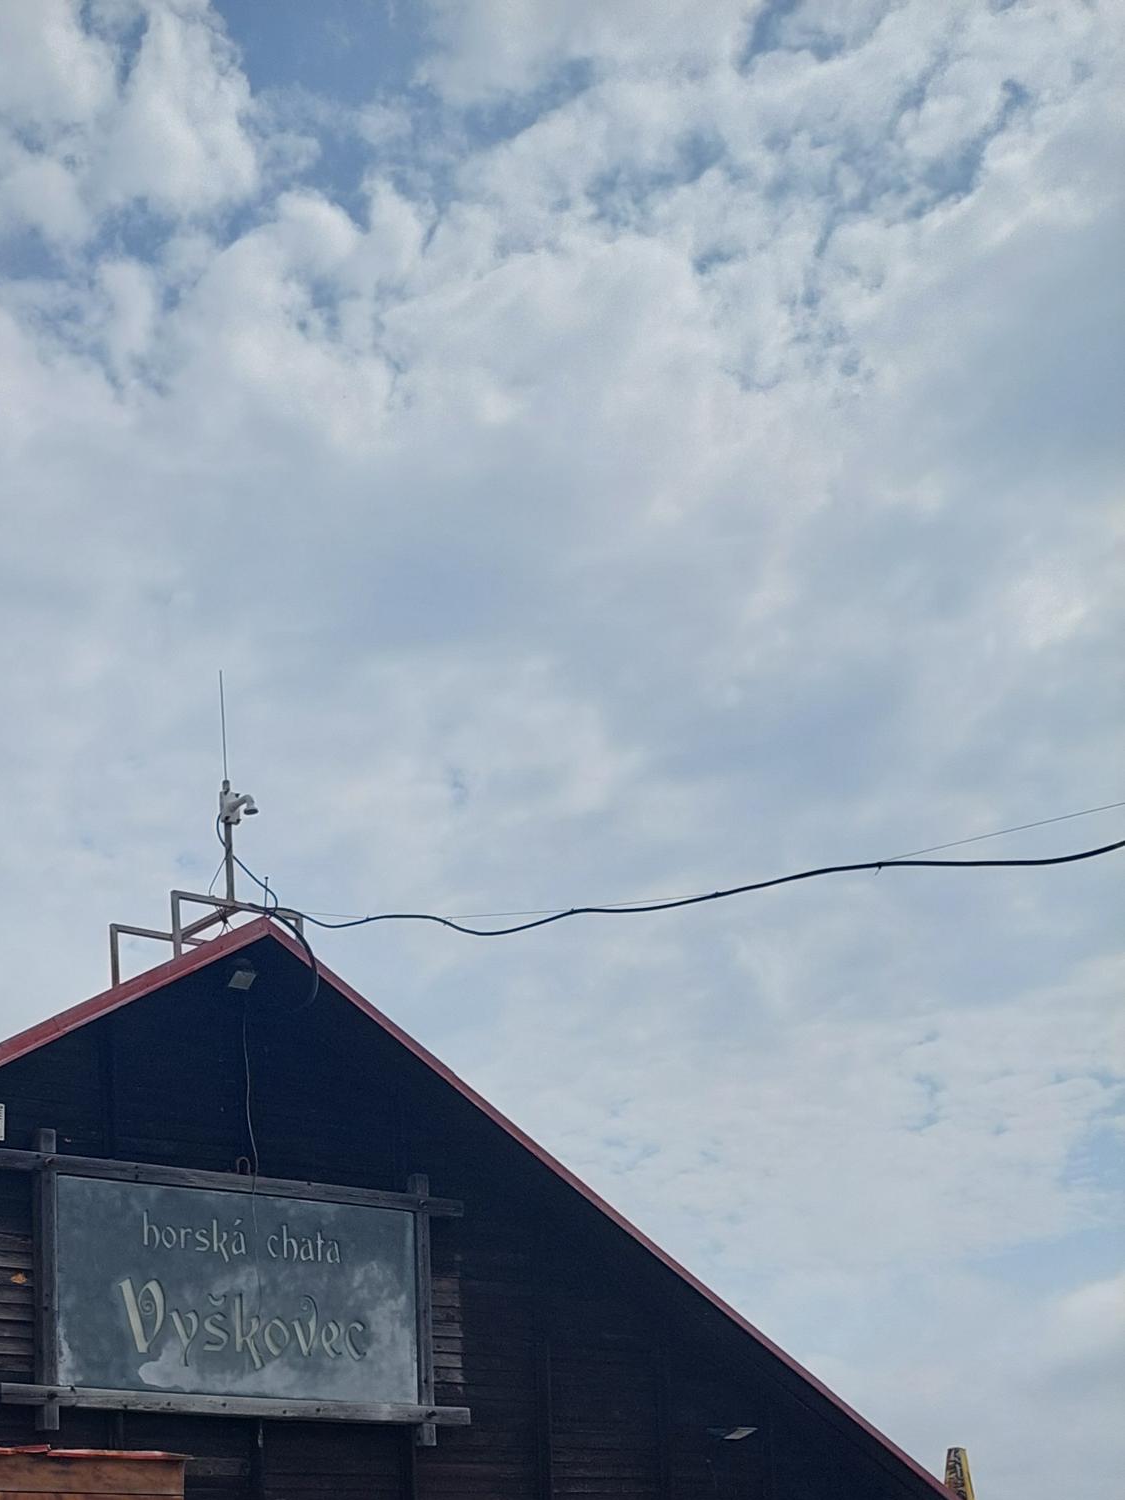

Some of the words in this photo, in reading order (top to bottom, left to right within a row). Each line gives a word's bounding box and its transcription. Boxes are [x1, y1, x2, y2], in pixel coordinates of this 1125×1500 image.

[143, 1209, 247, 1263] horská
[266, 1223, 341, 1264] chata
[118, 1276, 368, 1371] Vyškovec
